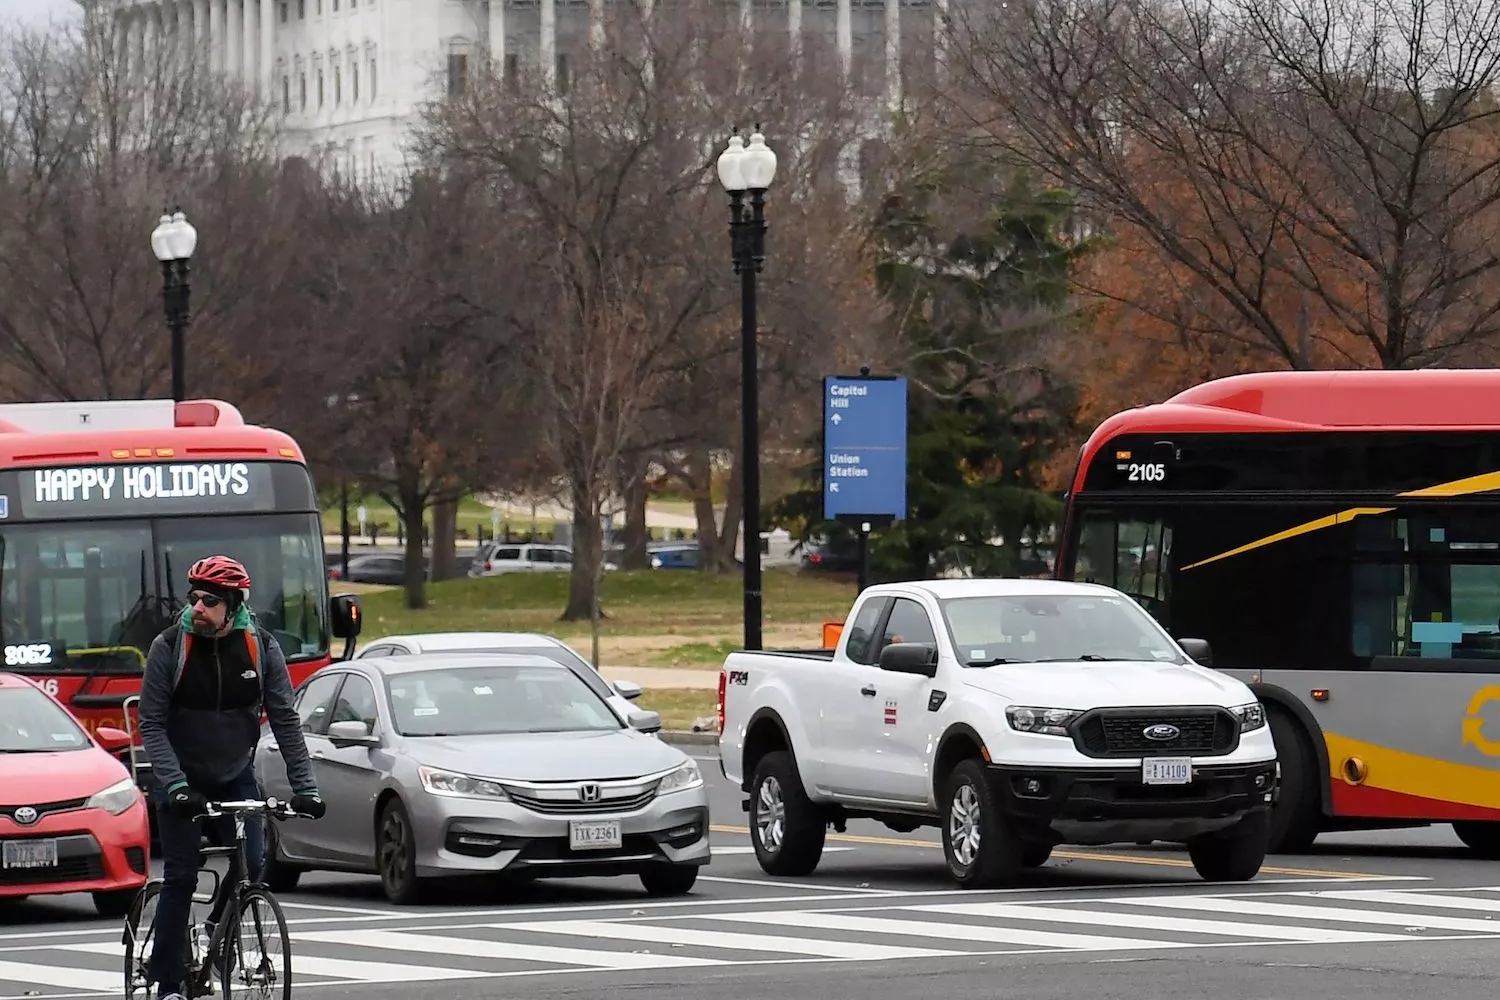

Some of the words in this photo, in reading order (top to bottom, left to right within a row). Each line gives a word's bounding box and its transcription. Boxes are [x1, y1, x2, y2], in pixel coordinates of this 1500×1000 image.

[830, 385, 867, 397] Capitol
[830, 398, 850, 408] Hill
[829, 454, 861, 464] Union
[829, 466, 869, 477] Station
[1128, 463, 1165, 481] 2105
[34, 467, 116, 502] HAPPY
[122, 462, 250, 500] HOLIDAYS
[729, 671, 748, 686] FX4
[1161, 764, 1187, 778] 14109
